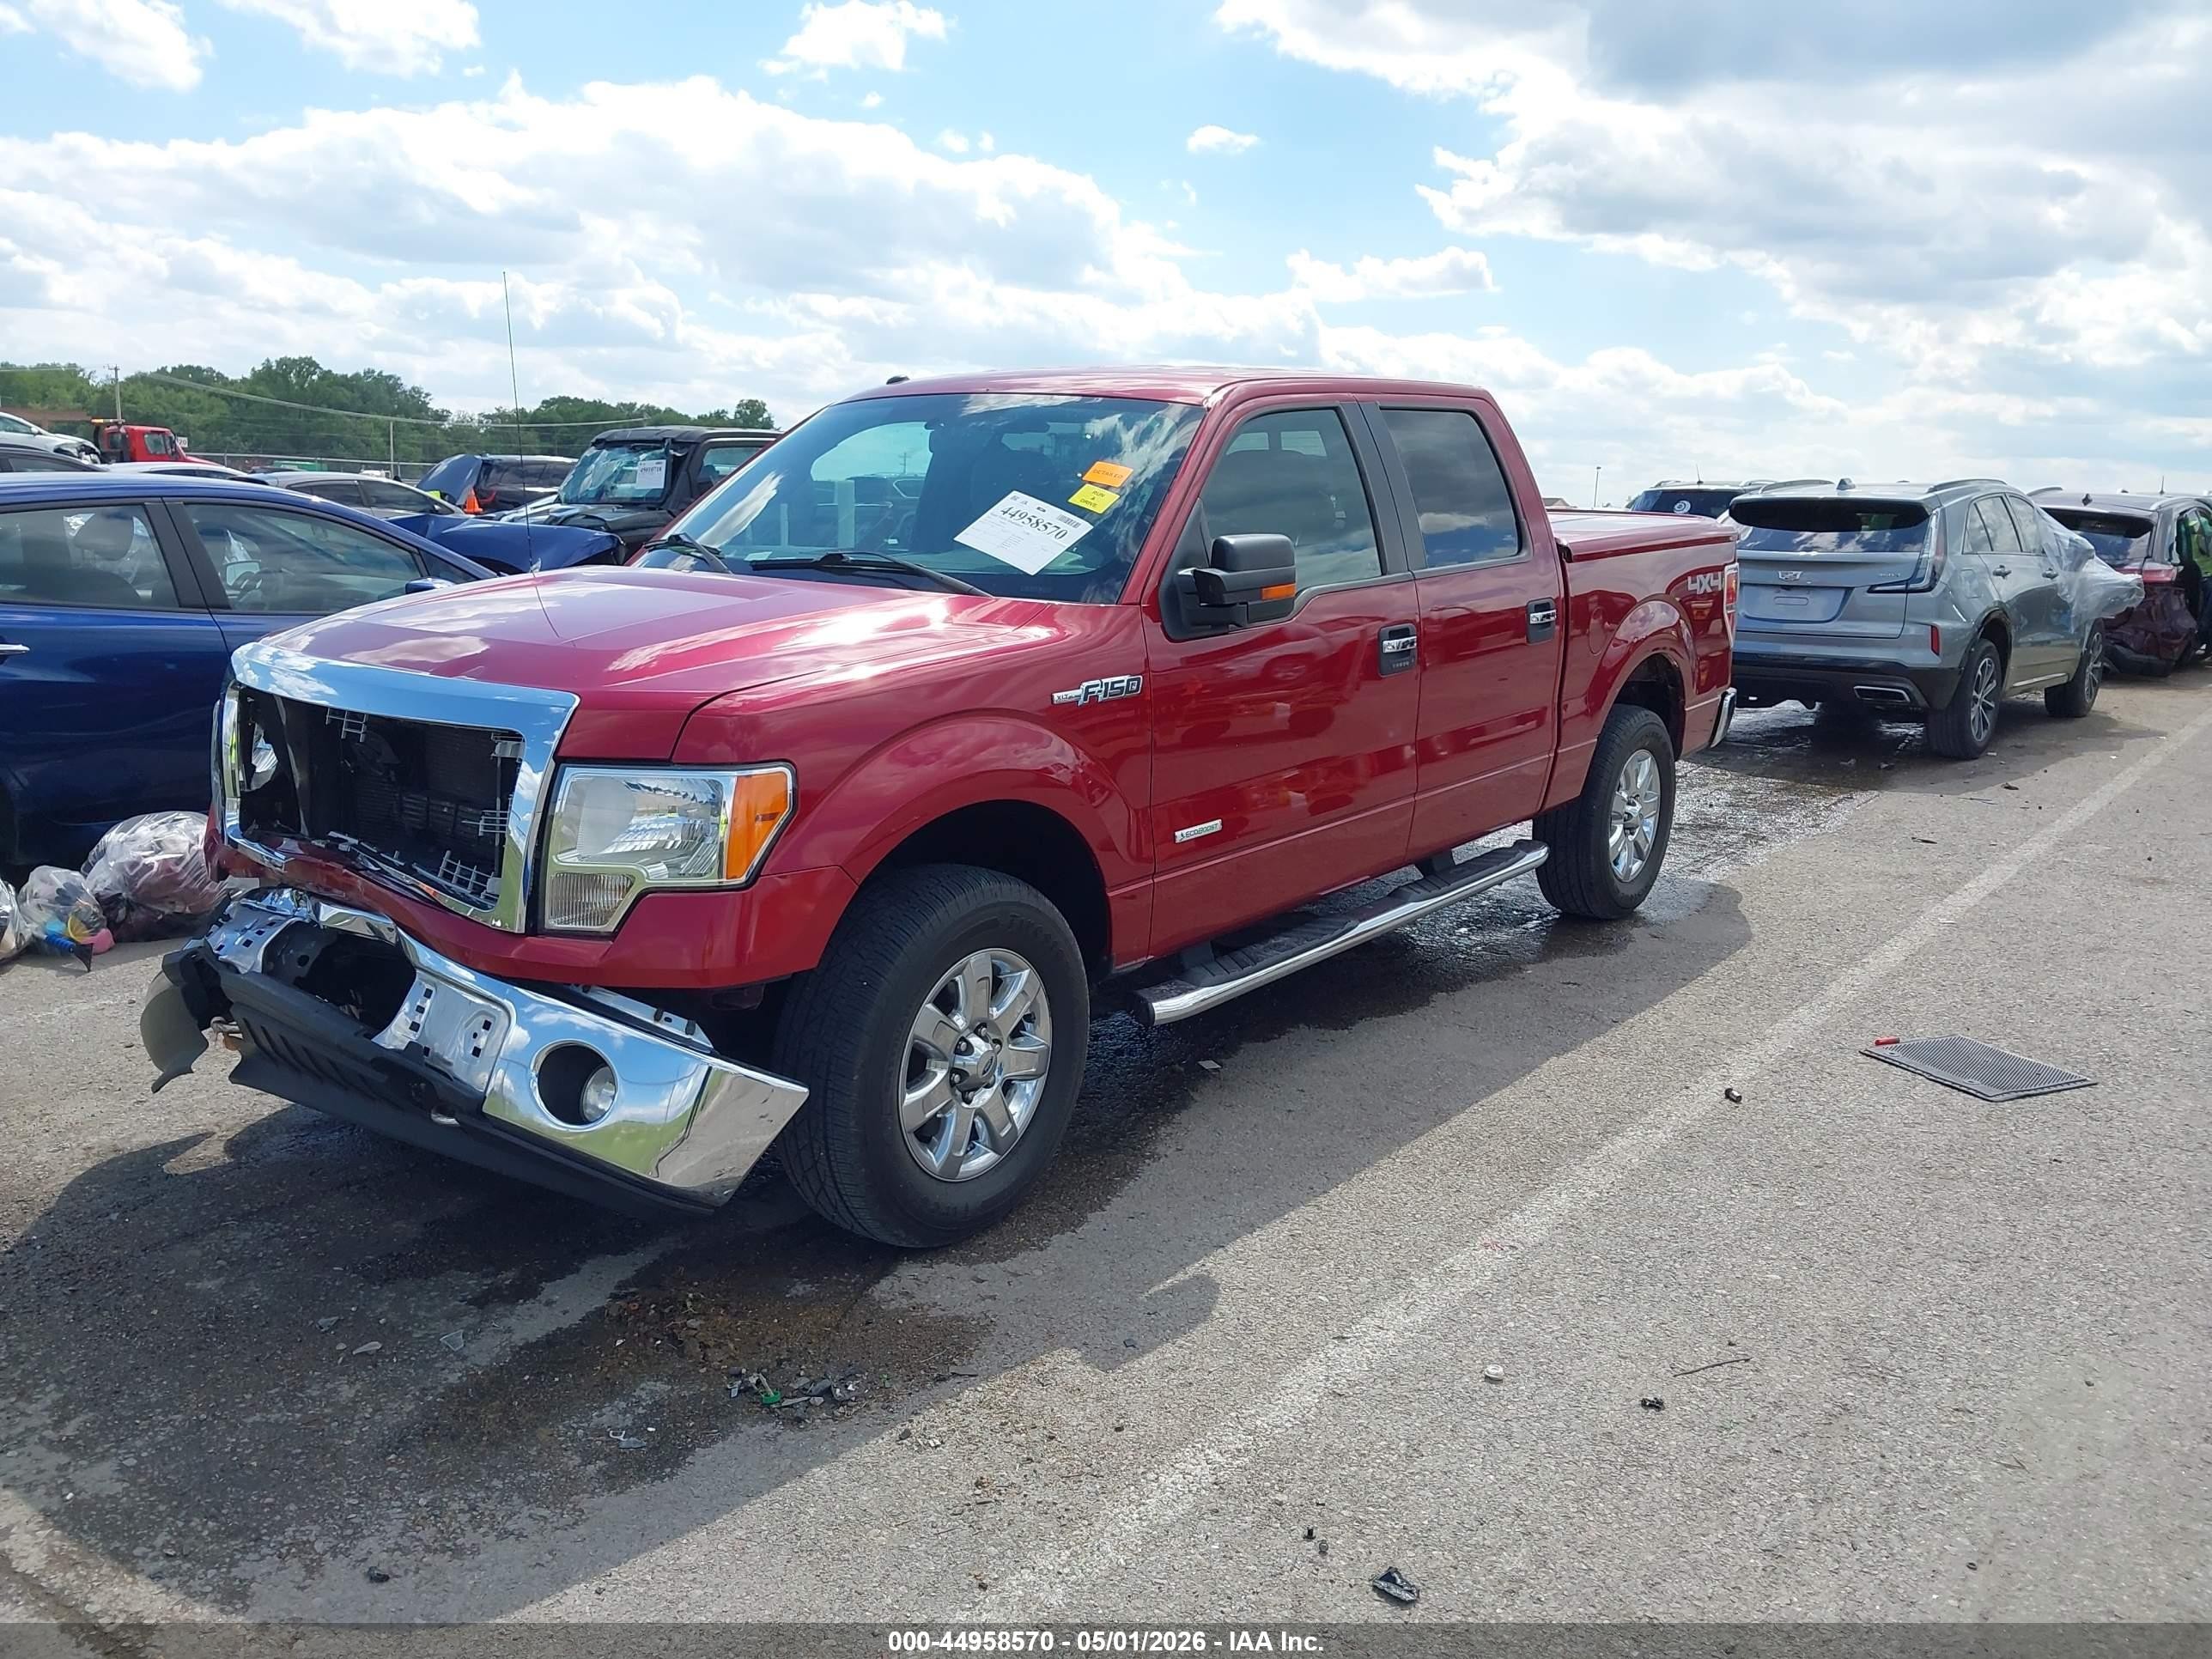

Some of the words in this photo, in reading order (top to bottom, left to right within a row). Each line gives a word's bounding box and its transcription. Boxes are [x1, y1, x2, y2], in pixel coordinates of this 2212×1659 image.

[1079, 499, 1098, 508] DRIVE
[1000, 506, 1068, 540] 44958570
[1079, 675, 1143, 705] F-150
